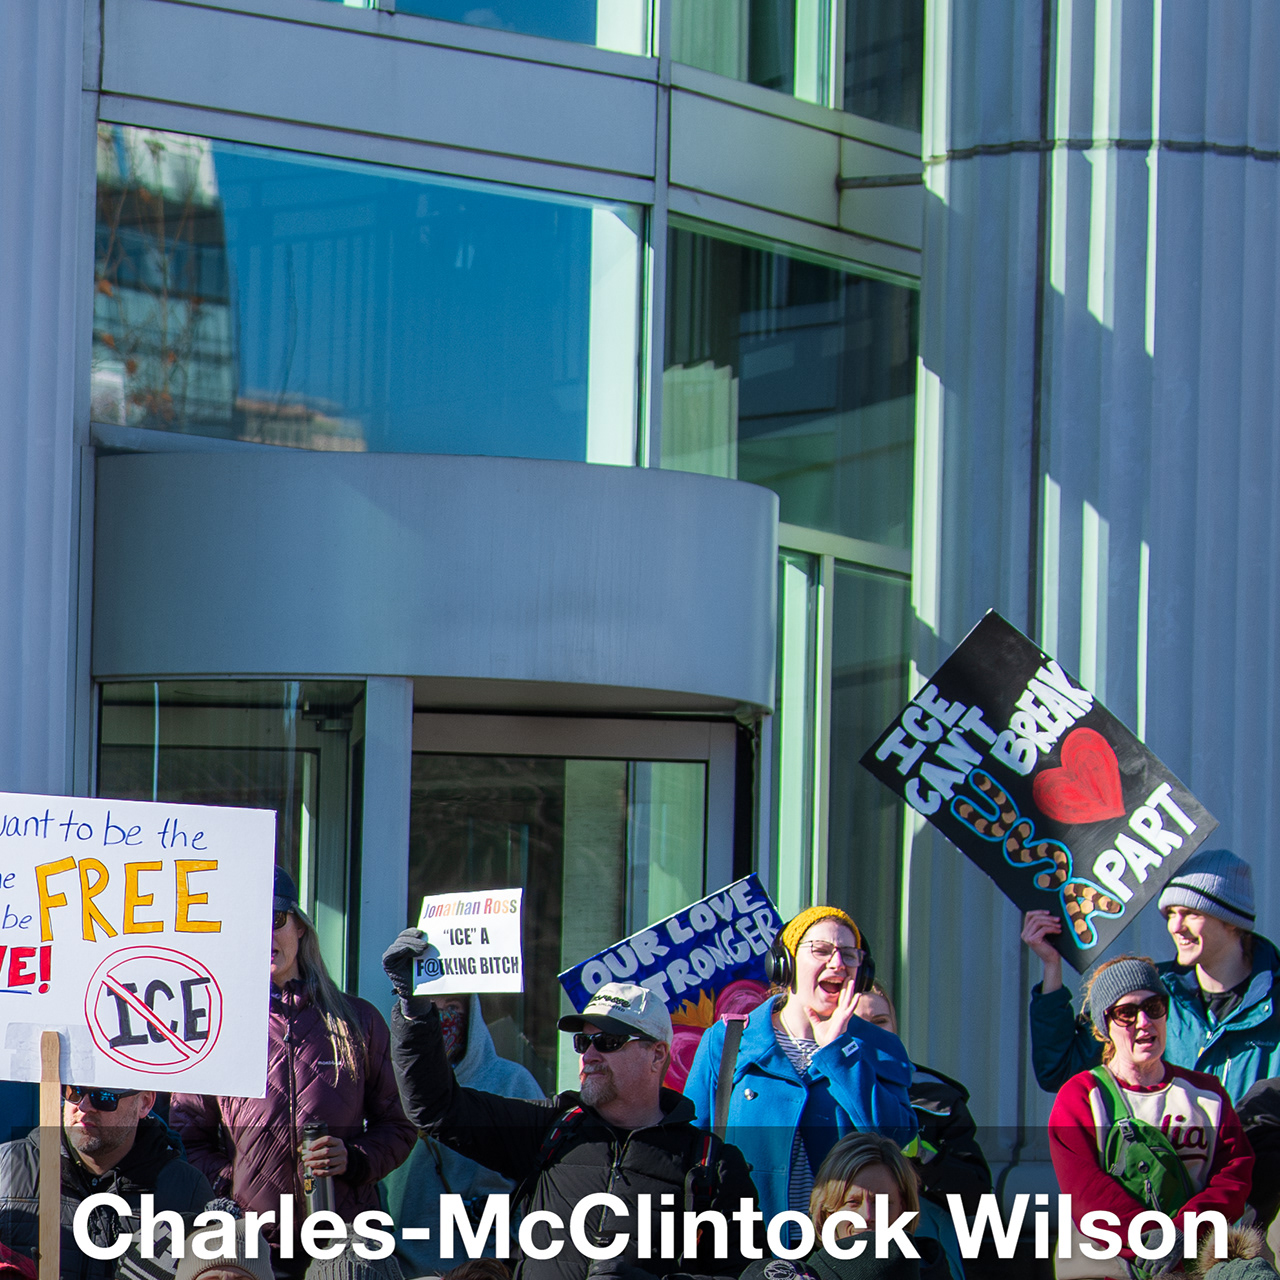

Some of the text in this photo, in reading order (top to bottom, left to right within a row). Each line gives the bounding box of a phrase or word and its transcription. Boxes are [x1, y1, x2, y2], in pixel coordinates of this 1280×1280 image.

[875, 683, 967, 776] ICE
[989, 658, 1095, 777] BREAK
[58, 813, 93, 843] to
[103, 809, 143, 847] be
[157, 816, 208, 851] the
[950, 768, 1125, 949] USA
[1092, 781, 1198, 904] PART
[2, 900, 33, 932] be
[35, 855, 222, 943] FREE
[423, 897, 517, 919] Jonathan Ross
[480, 927, 490, 945] A
[581, 879, 767, 995] OUR LOVE
[480, 956, 519, 975] BITCH
[640, 907, 780, 1004] TRONGER
[106, 976, 213, 1050] ICE
